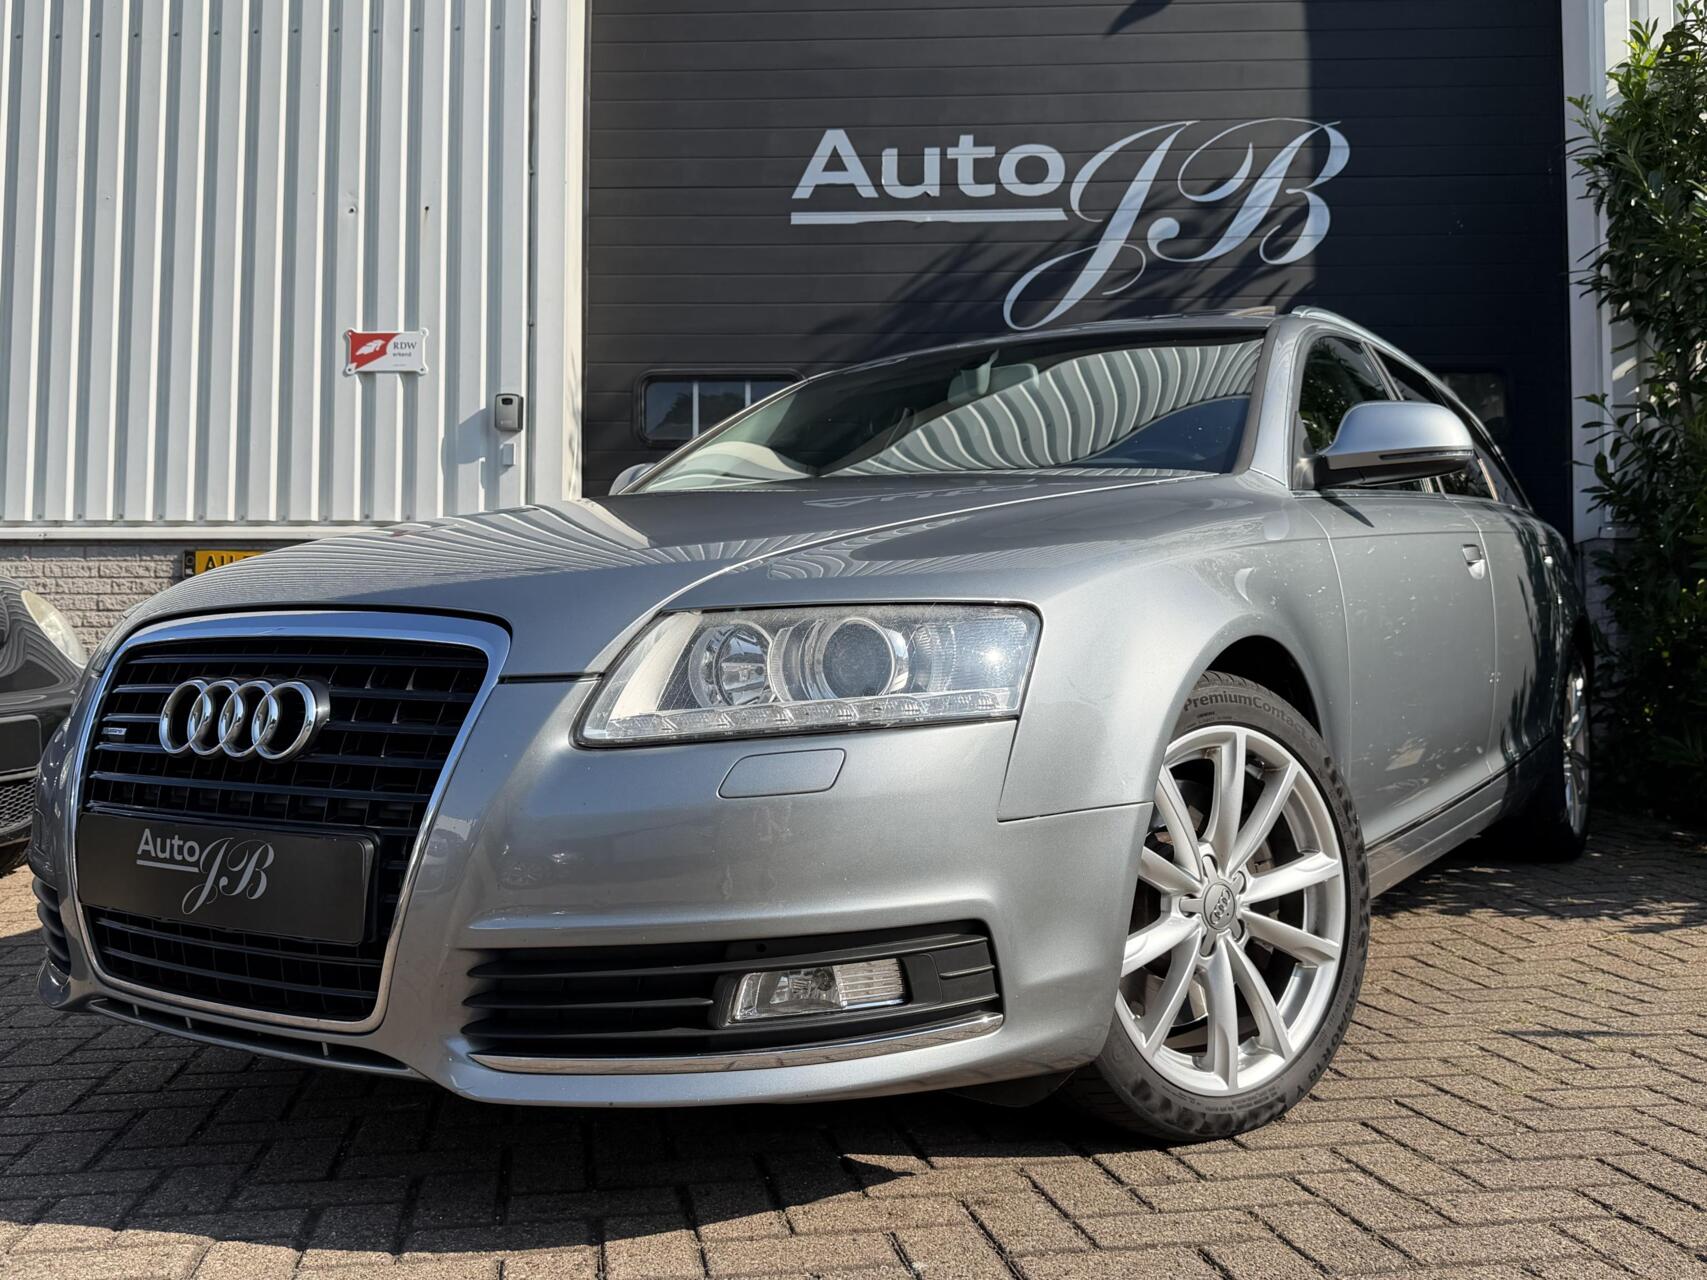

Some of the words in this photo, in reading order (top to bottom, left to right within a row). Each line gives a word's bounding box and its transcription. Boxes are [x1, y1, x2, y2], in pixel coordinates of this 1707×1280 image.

[791, 128, 1066, 199] Auto
[1002, 117, 1351, 331] JB
[392, 341, 417, 350] RDW
[1183, 690, 1306, 738] PremiumContact
[136, 828, 200, 863] Auto
[181, 837, 275, 915] JB
